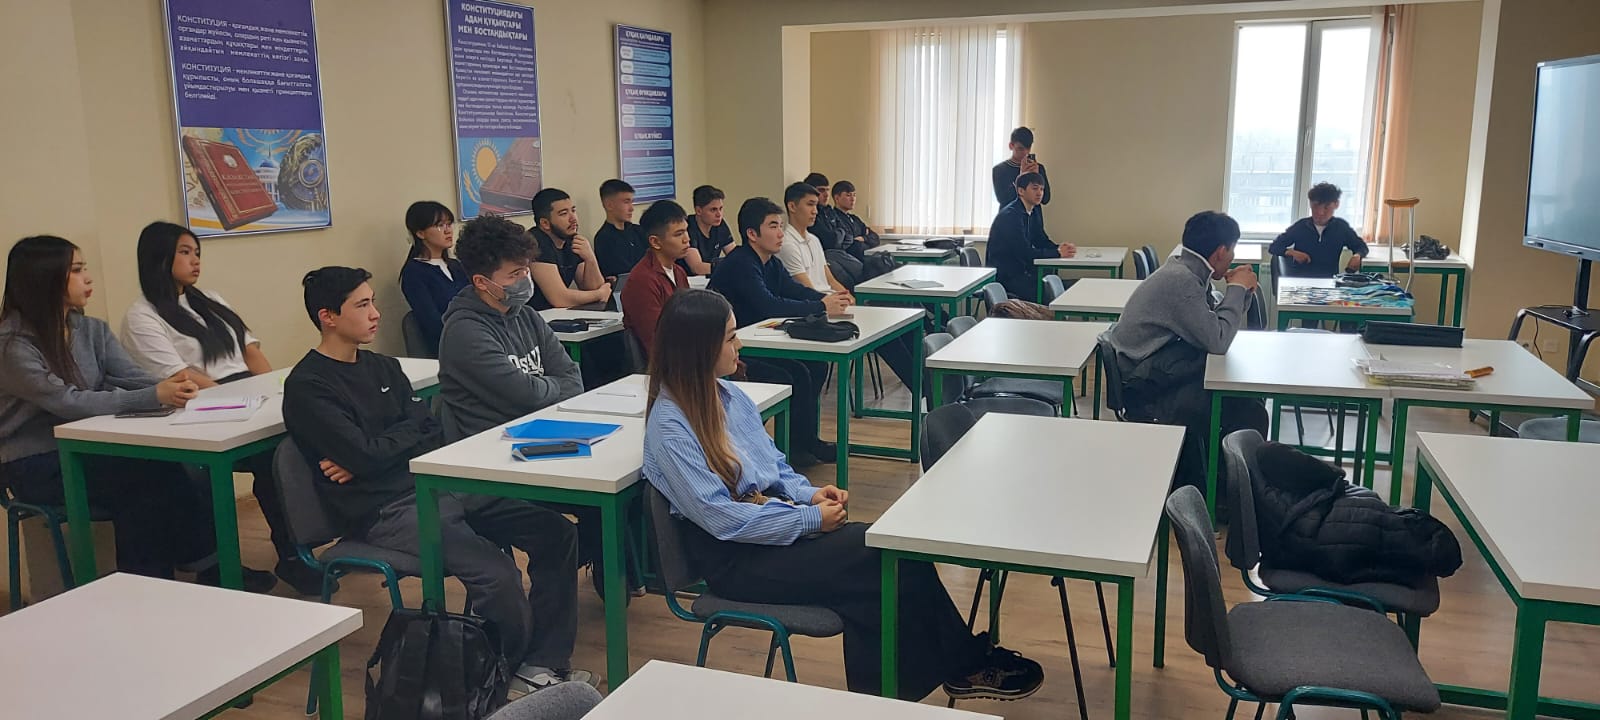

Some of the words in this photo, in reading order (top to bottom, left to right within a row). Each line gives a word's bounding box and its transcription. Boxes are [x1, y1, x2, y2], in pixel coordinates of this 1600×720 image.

[178, 16, 228, 28] КОНСТИТУЦИЯ
[464, 15, 483, 25] АДАМ
[458, 25, 472, 34] МЕН
[474, 27, 528, 40] БОСТАНДЫҚТАРЫ
[182, 64, 231, 73] КОНСТИТУЦИЯ
